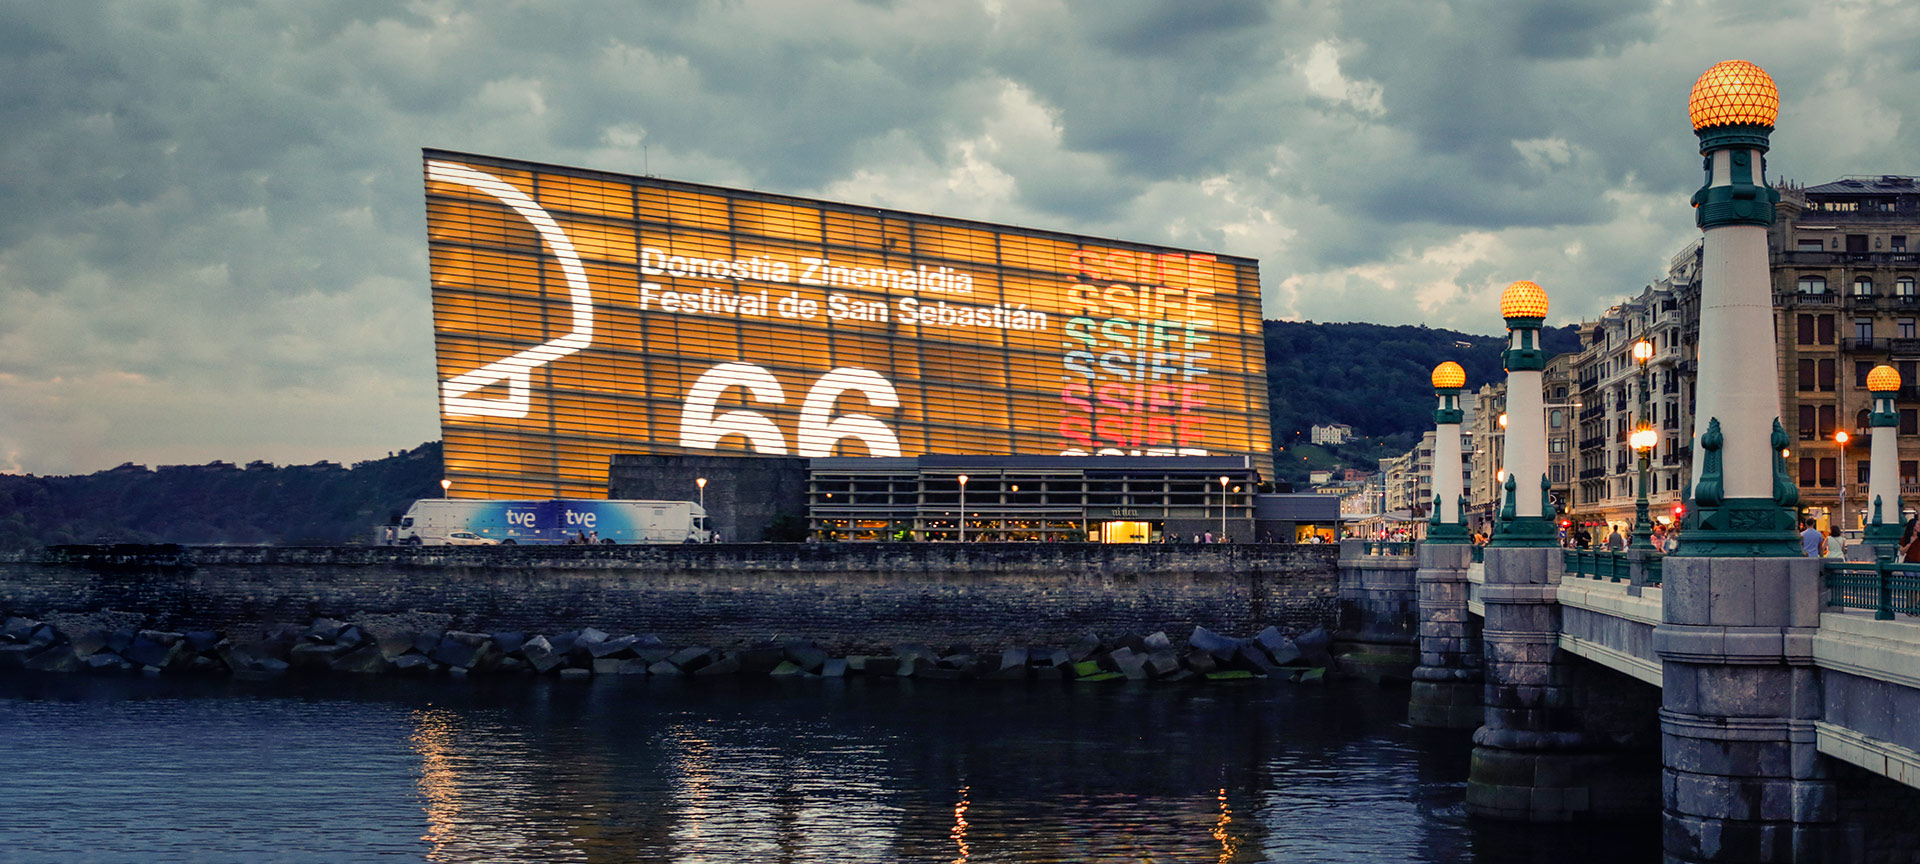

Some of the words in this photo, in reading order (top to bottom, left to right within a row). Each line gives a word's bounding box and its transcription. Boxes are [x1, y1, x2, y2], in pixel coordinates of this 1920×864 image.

[641, 247, 790, 283] Donostia
[799, 256, 973, 294] Zinemaldia
[1066, 250, 1217, 284] SSIFF
[640, 282, 768, 316] Festival
[778, 291, 818, 319] de
[827, 293, 888, 323] San
[897, 297, 1047, 331] Sebastián
[1064, 283, 1216, 317] SSIFF
[1062, 317, 1214, 350] SSIFF
[1060, 350, 1212, 381] SSIFF
[679, 361, 902, 457] 66
[1059, 383, 1210, 414] SSIFF
[1057, 416, 1209, 447] SSIFF
[506, 509, 536, 528] tve
[565, 509, 597, 528] tve
